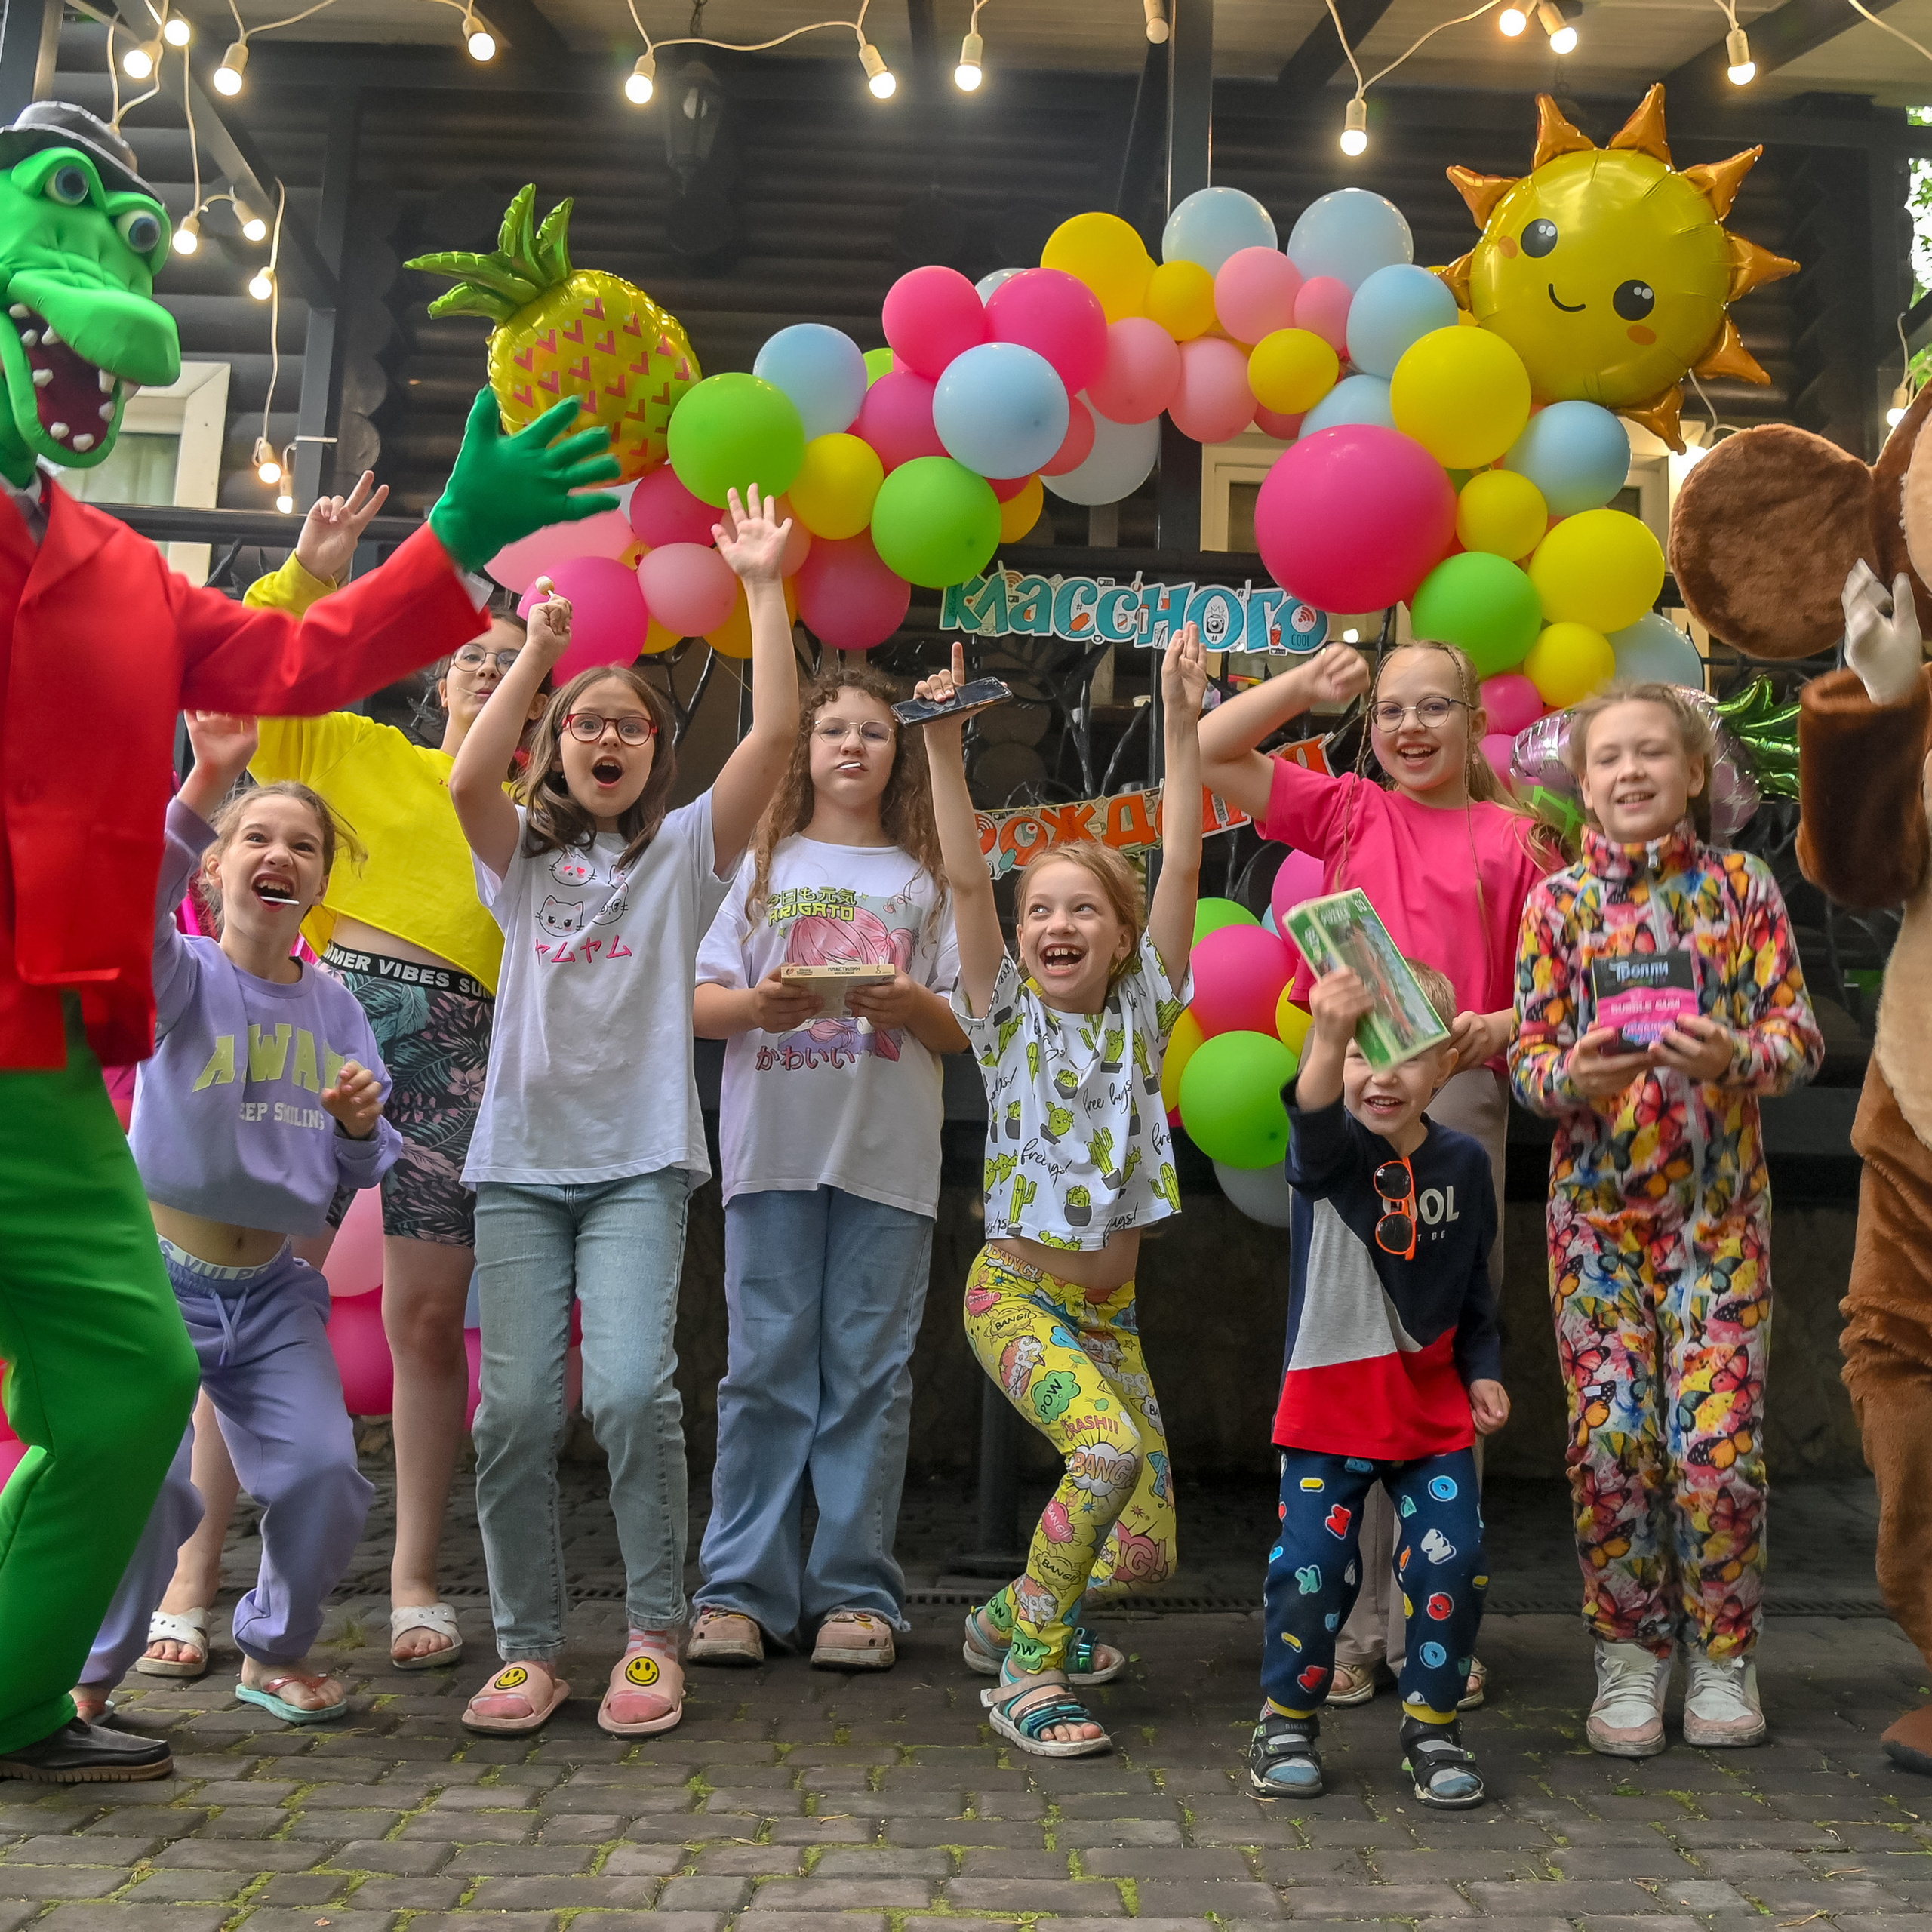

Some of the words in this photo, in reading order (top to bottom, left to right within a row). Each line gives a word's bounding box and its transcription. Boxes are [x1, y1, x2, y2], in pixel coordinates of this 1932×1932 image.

[1291, 634, 1309, 647] COOL
[768, 903, 855, 927] ARIGATO
[379, 959, 450, 987] VIBES
[755, 1045, 856, 1071] かわいい
[1040, 1378, 1063, 1415] POW
